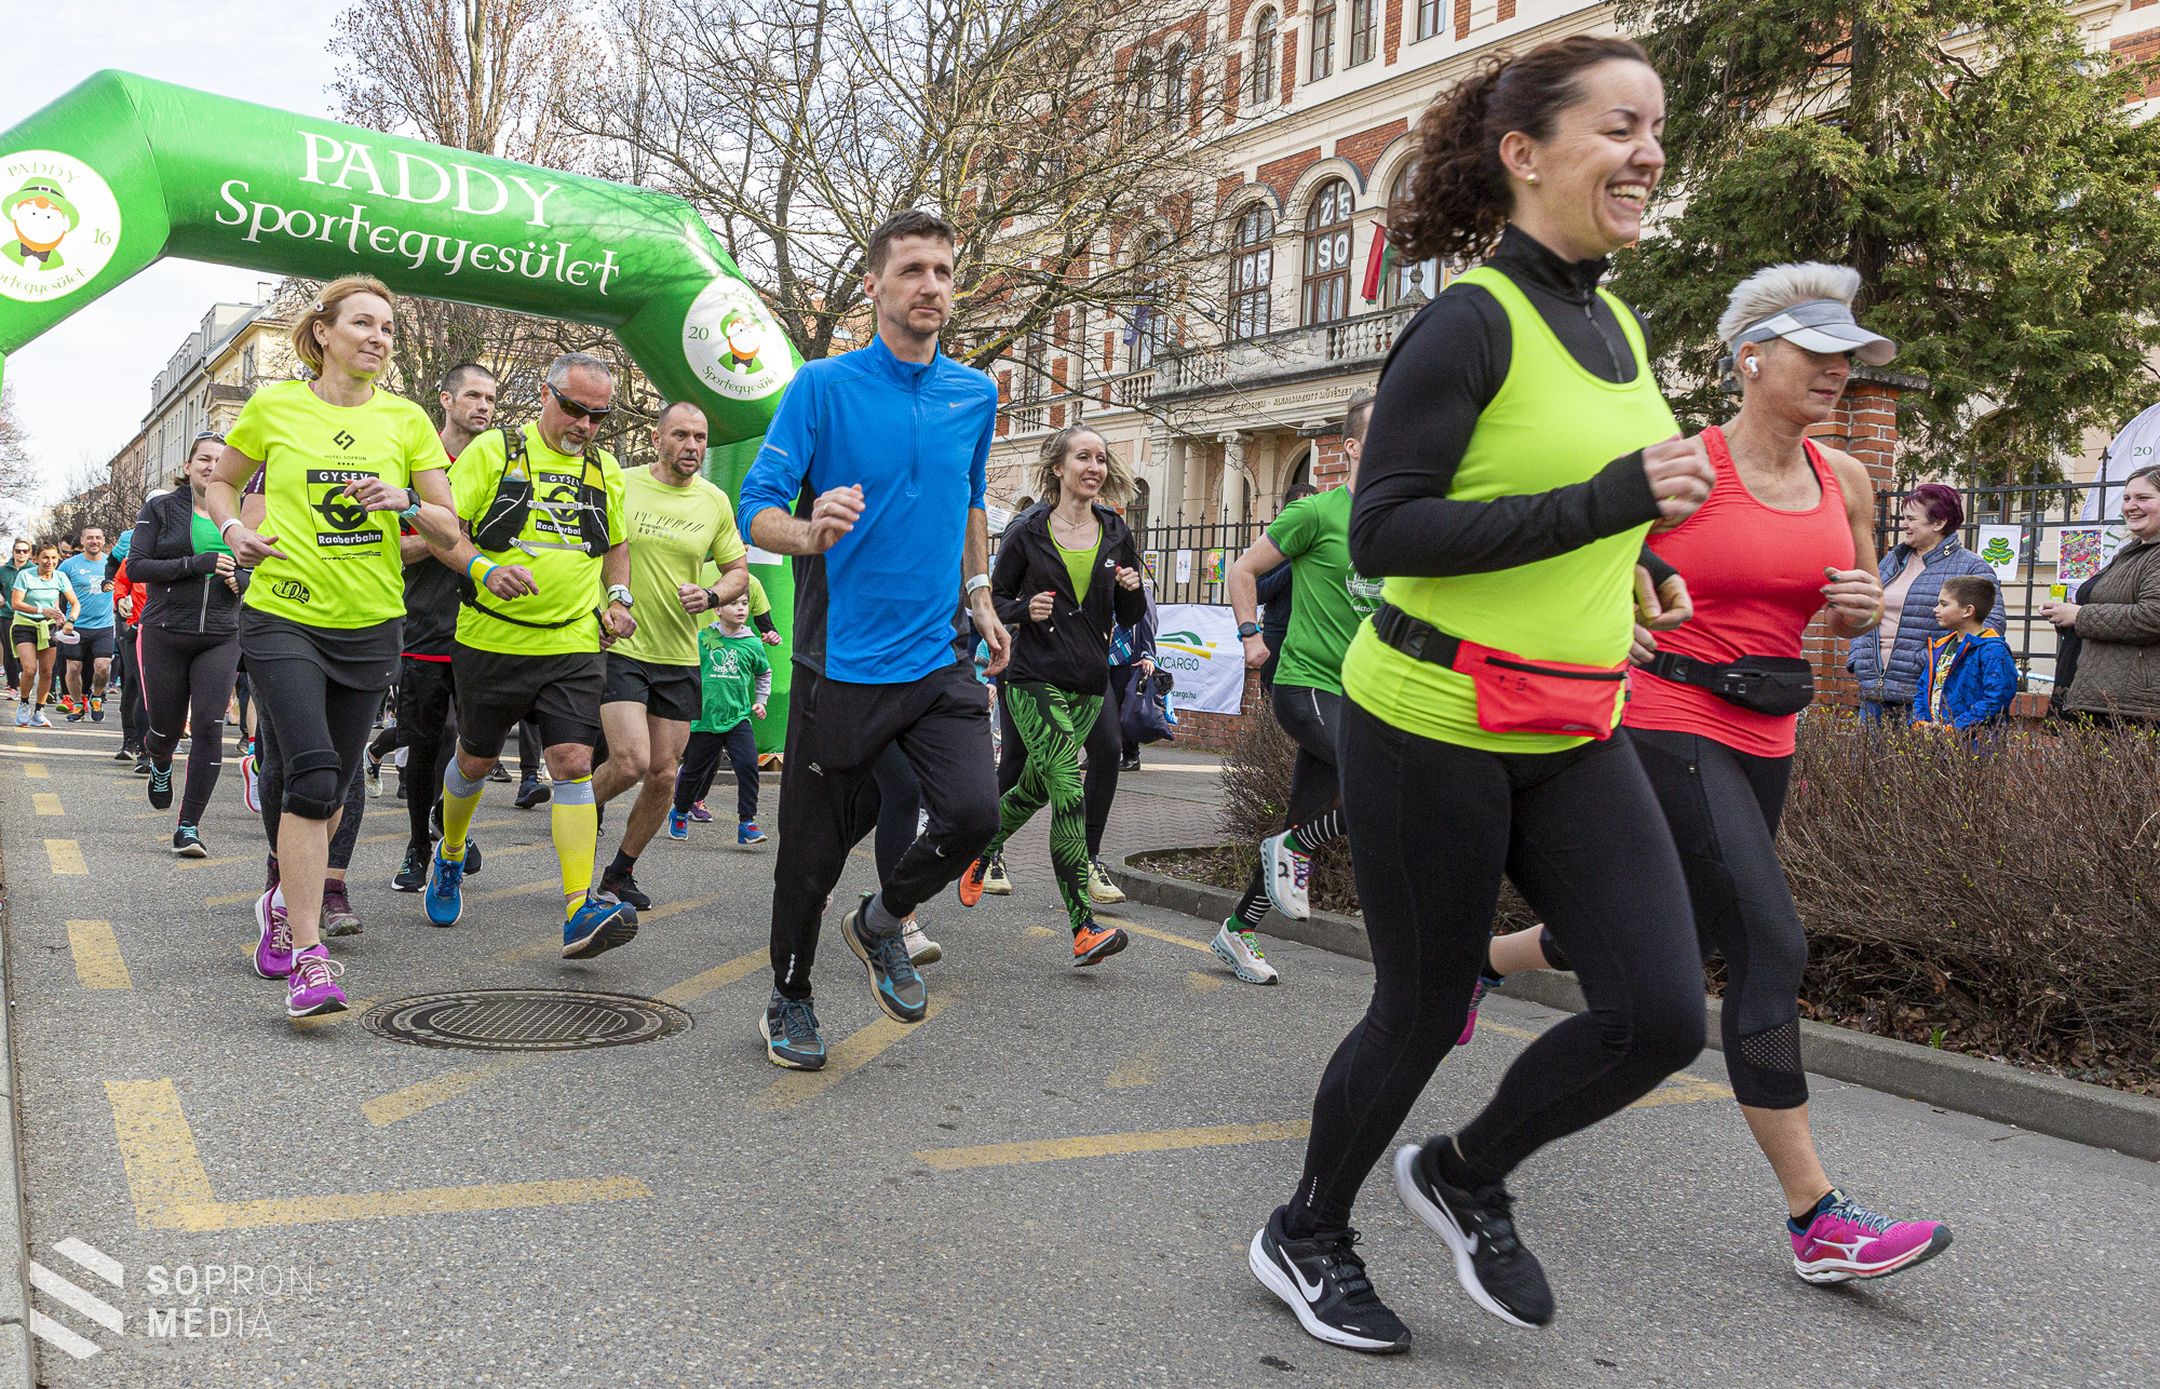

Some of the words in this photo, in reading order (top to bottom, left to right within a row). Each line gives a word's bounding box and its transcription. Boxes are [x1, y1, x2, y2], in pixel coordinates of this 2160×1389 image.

[8, 162, 80, 184] PADDY
[296, 130, 561, 228] PADDY
[94, 228, 111, 246] 16
[215, 179, 620, 295] Sportegyesület
[1318, 234, 1349, 267] SO
[688, 326, 709, 341] 20
[2133, 446, 2152, 457] 20
[318, 532, 381, 545] Raaberbahn
